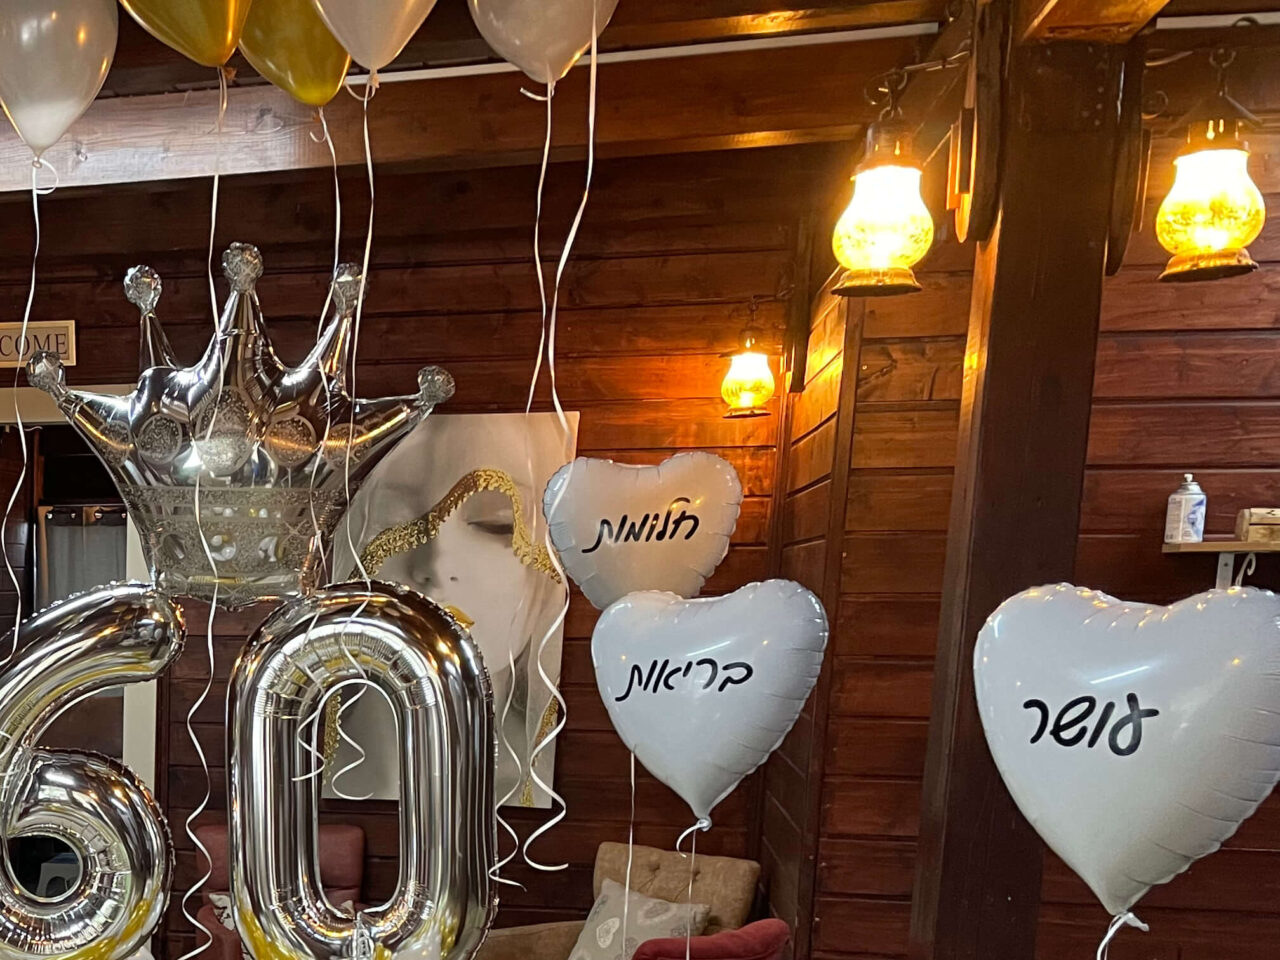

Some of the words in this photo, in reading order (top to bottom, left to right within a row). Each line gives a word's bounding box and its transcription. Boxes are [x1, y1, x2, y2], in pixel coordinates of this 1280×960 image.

[581, 497, 700, 553] חלומות
[614, 657, 754, 703] בריאות
[1023, 692, 1160, 757] עושר
